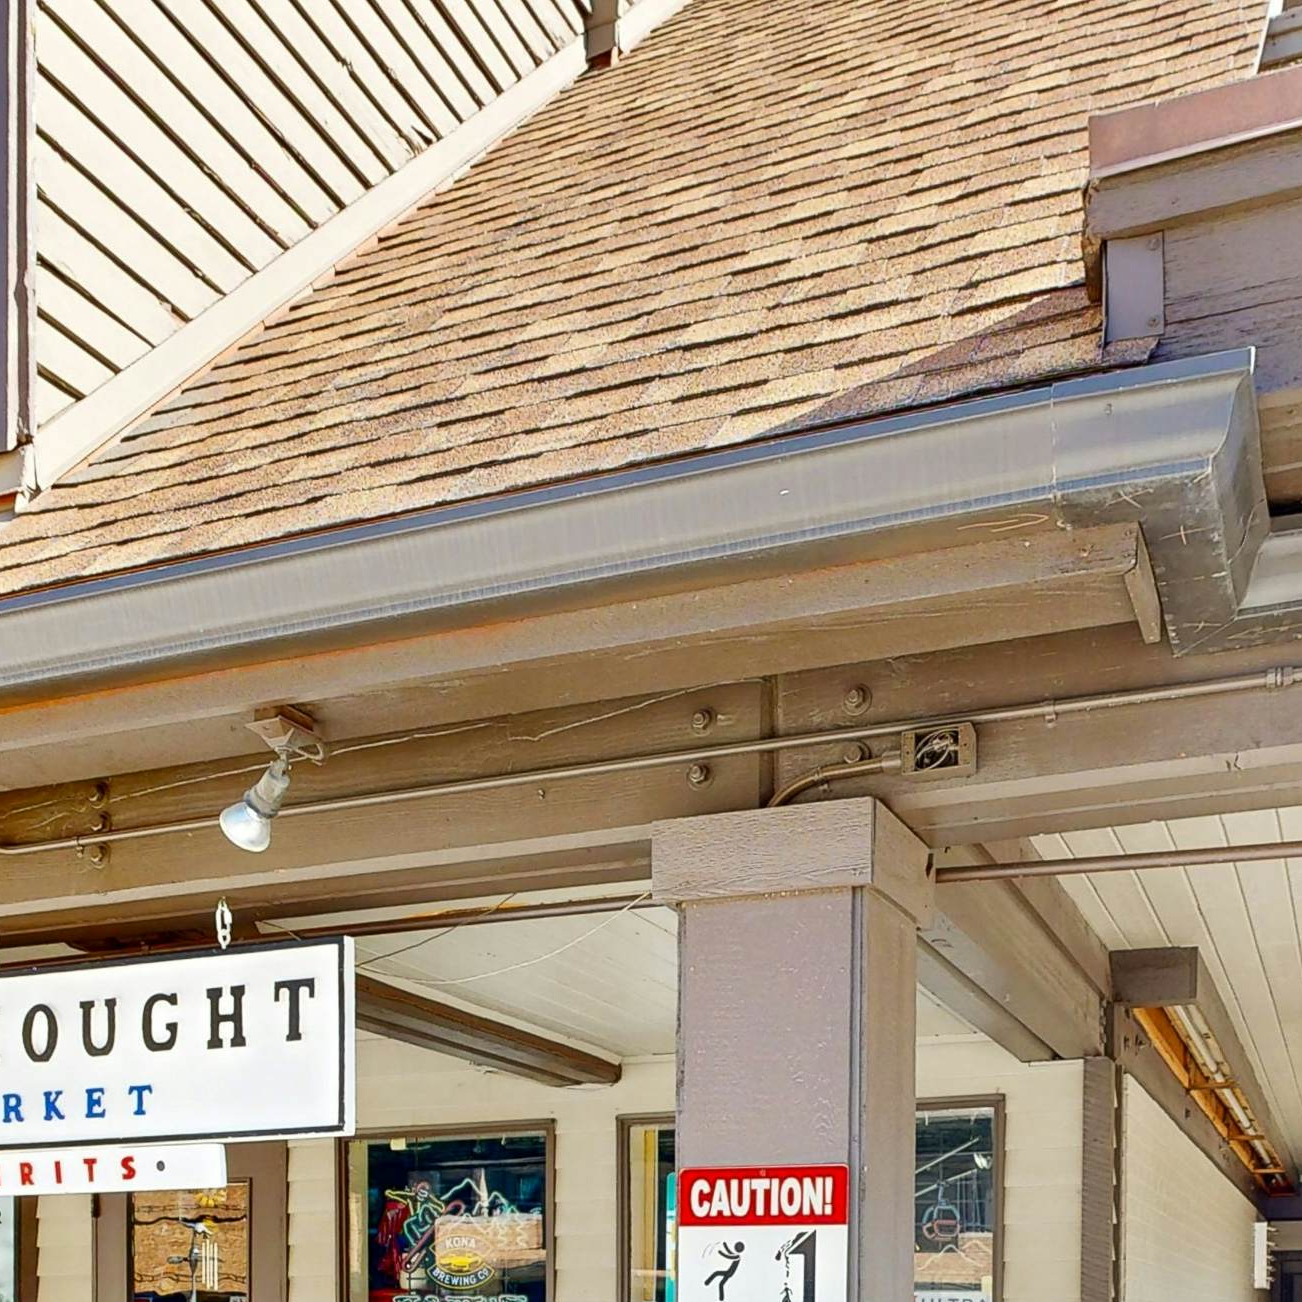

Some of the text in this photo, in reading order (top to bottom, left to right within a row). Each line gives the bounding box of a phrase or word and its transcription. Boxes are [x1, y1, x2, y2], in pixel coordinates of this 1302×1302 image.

[690, 1176, 834, 1218] CAUTION!
[445, 1236, 476, 1249] KONA
[432, 1267, 476, 1286] BREWING
